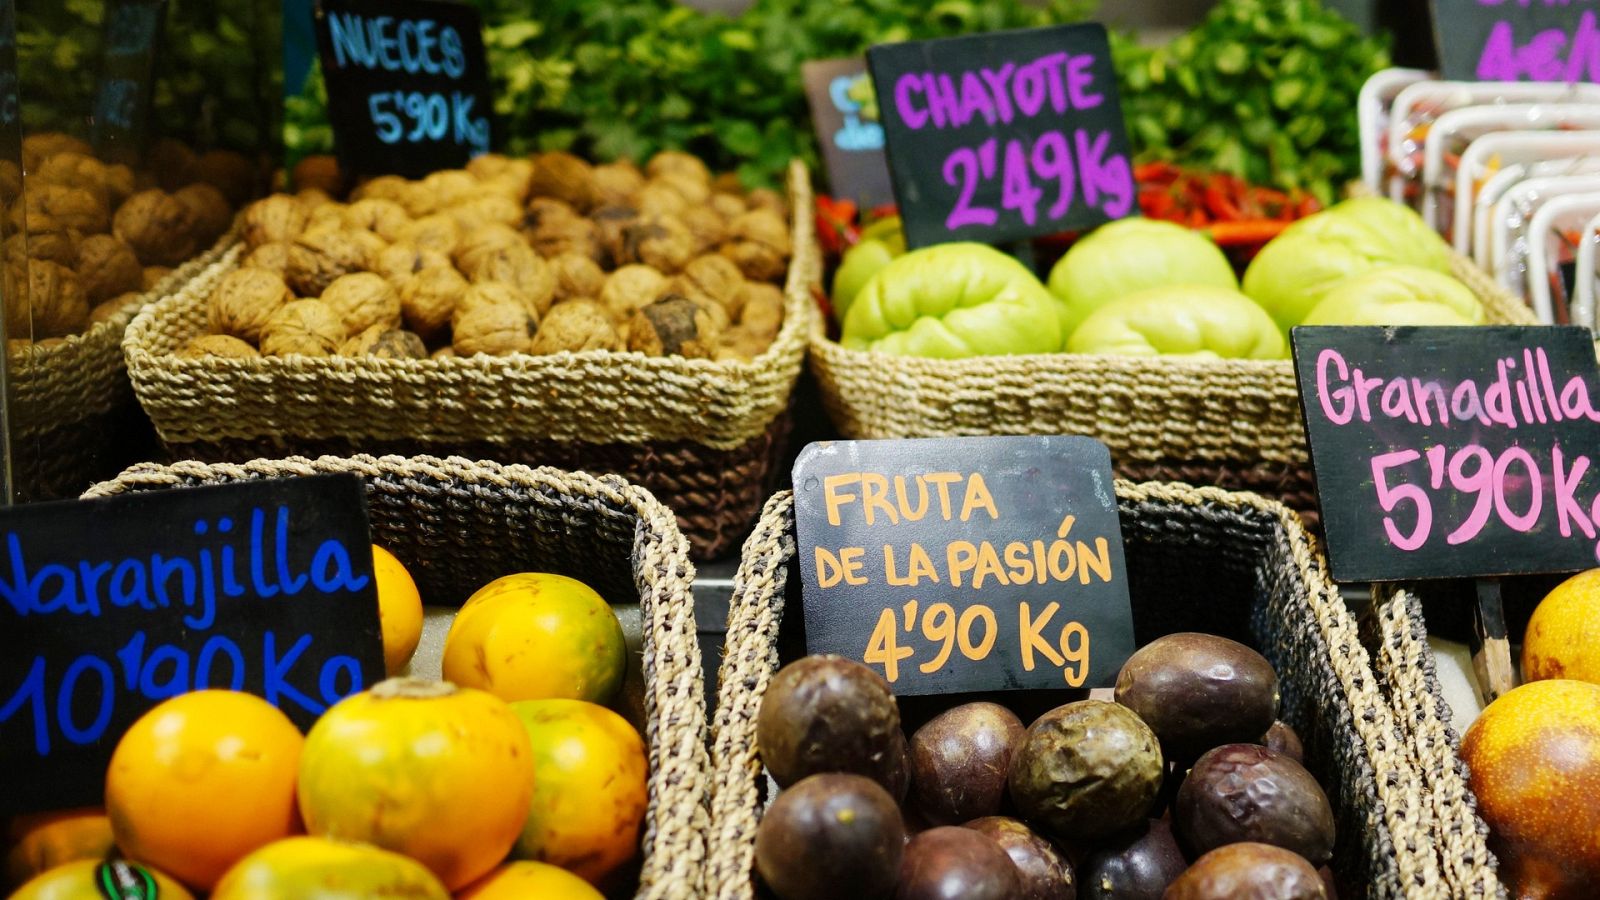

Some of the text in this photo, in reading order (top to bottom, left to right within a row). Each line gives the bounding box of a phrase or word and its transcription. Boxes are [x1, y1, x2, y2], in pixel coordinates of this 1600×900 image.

[328, 10, 465, 79] NUECES
[368, 90, 490, 160] 5'90 Kg
[894, 51, 1105, 130] CHAYOTE
[1316, 346, 1600, 429] Granadilla
[823, 472, 999, 526] FRUTA
[1370, 441, 1600, 563] 5'90 K
[814, 514, 1113, 589] DE LA PASIÓN
[863, 599, 1090, 688] 4'90 Kg
